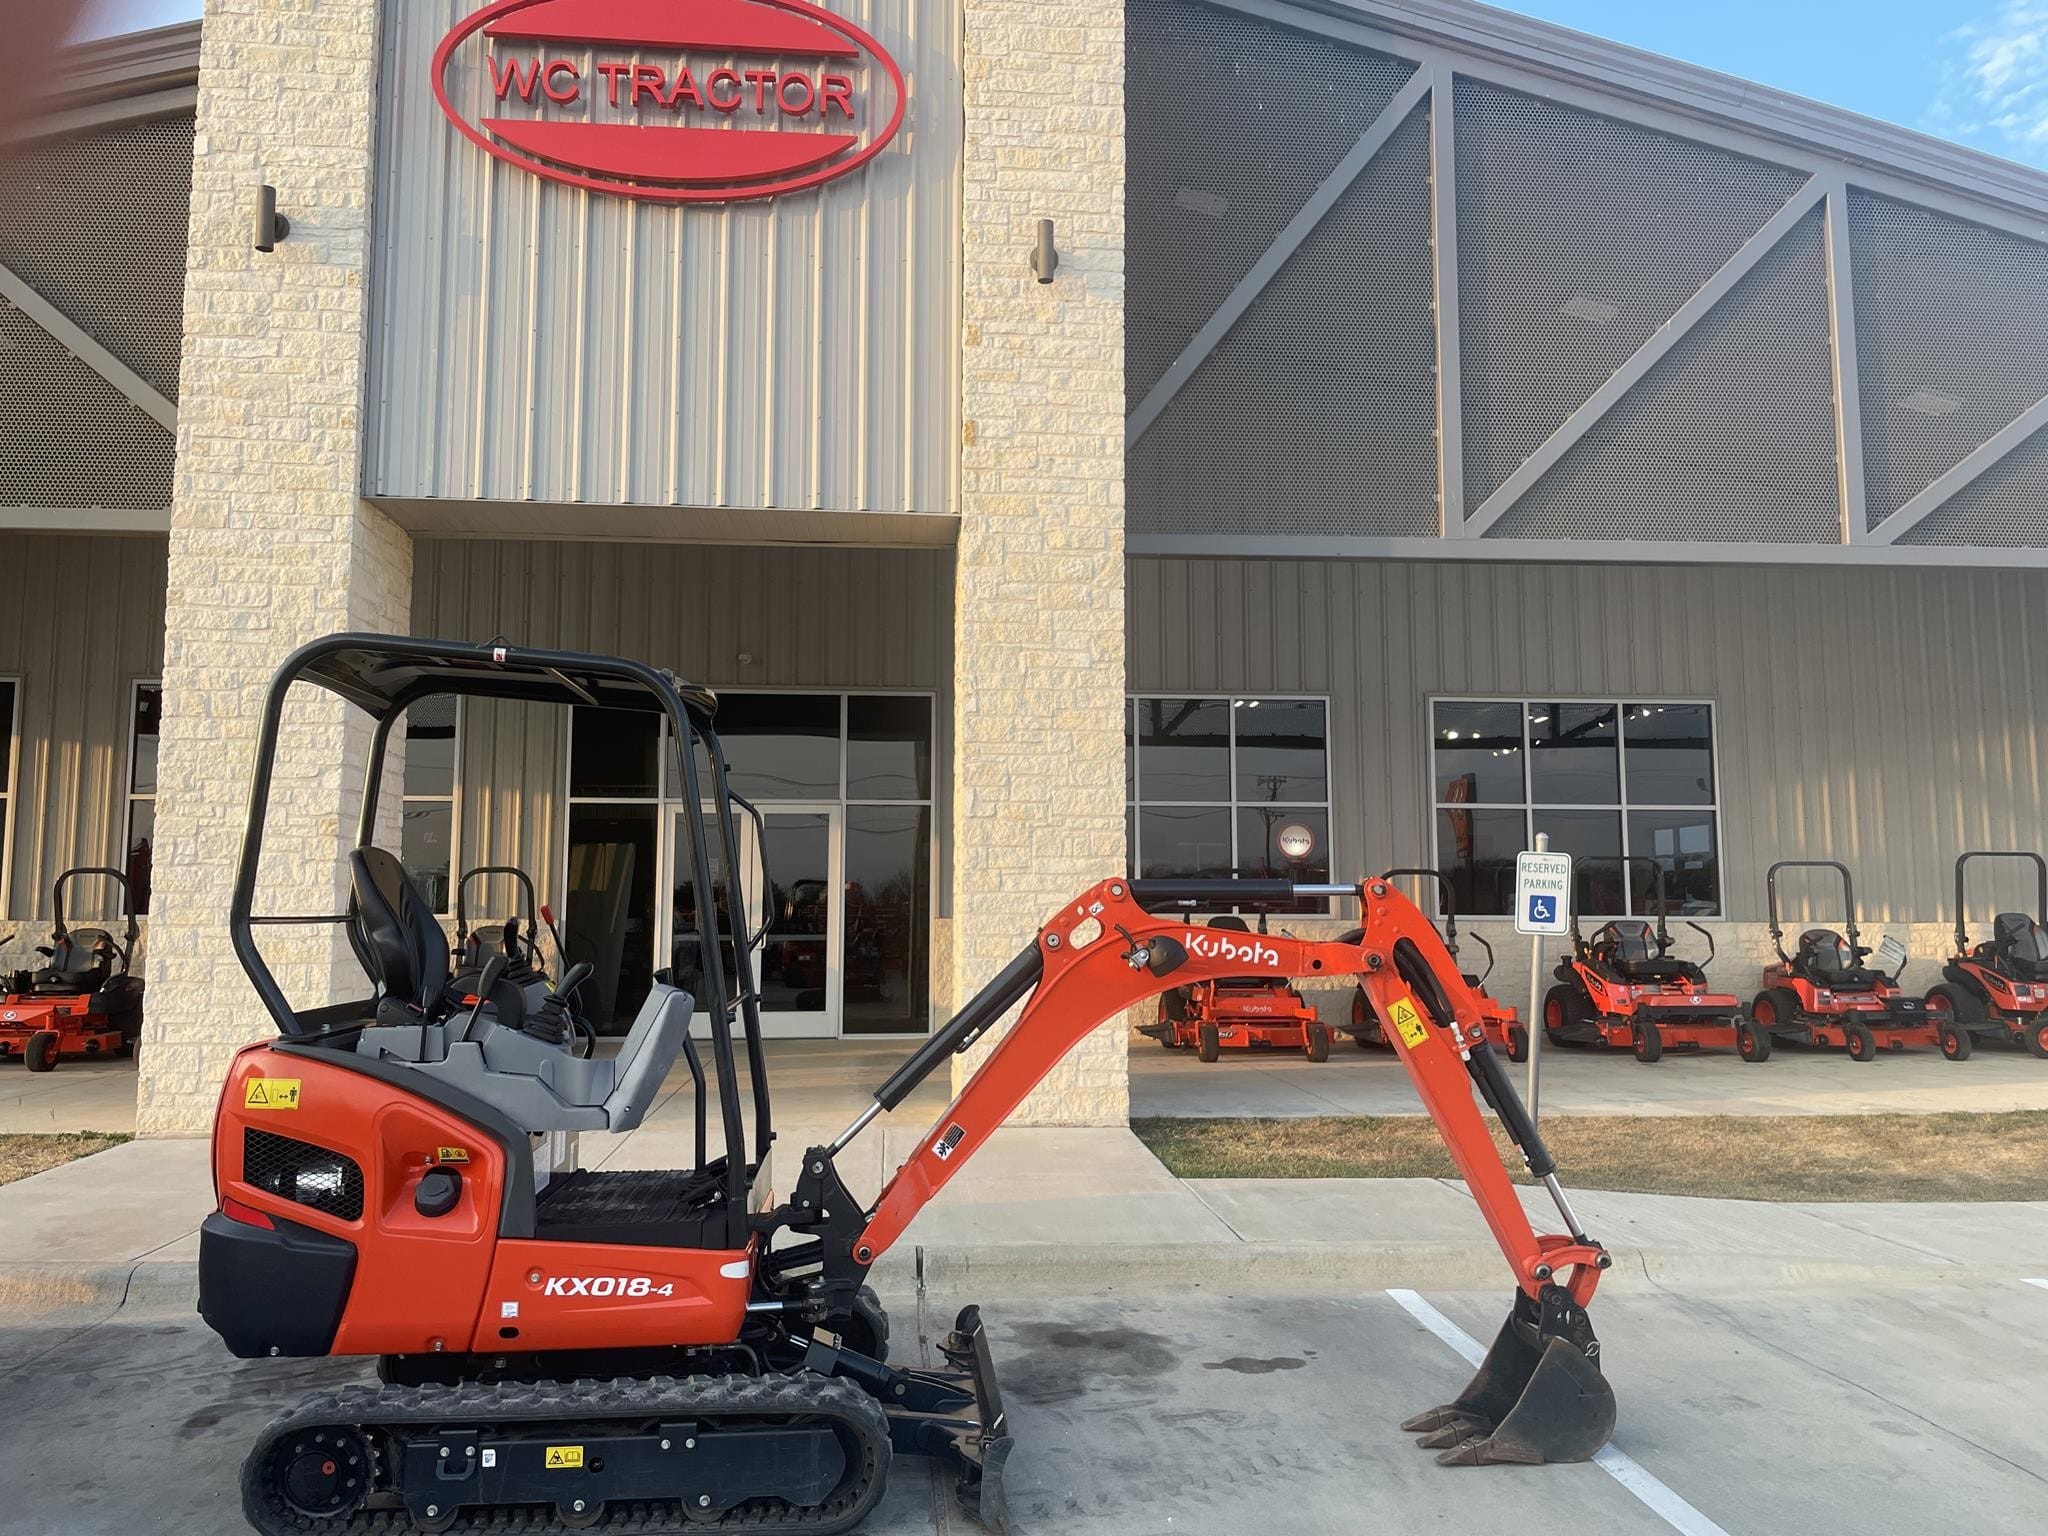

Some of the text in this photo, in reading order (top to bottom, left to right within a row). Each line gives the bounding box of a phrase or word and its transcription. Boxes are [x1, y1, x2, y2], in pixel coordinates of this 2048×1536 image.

[487, 55, 854, 119] WC TRACTOR
[1521, 862, 1567, 874] RESERVED
[1523, 878, 1563, 890] PARKING
[1185, 932, 1279, 967] Kubota
[1242, 1004, 1272, 1013] Kubota
[543, 1277, 674, 1297] KX018-4
